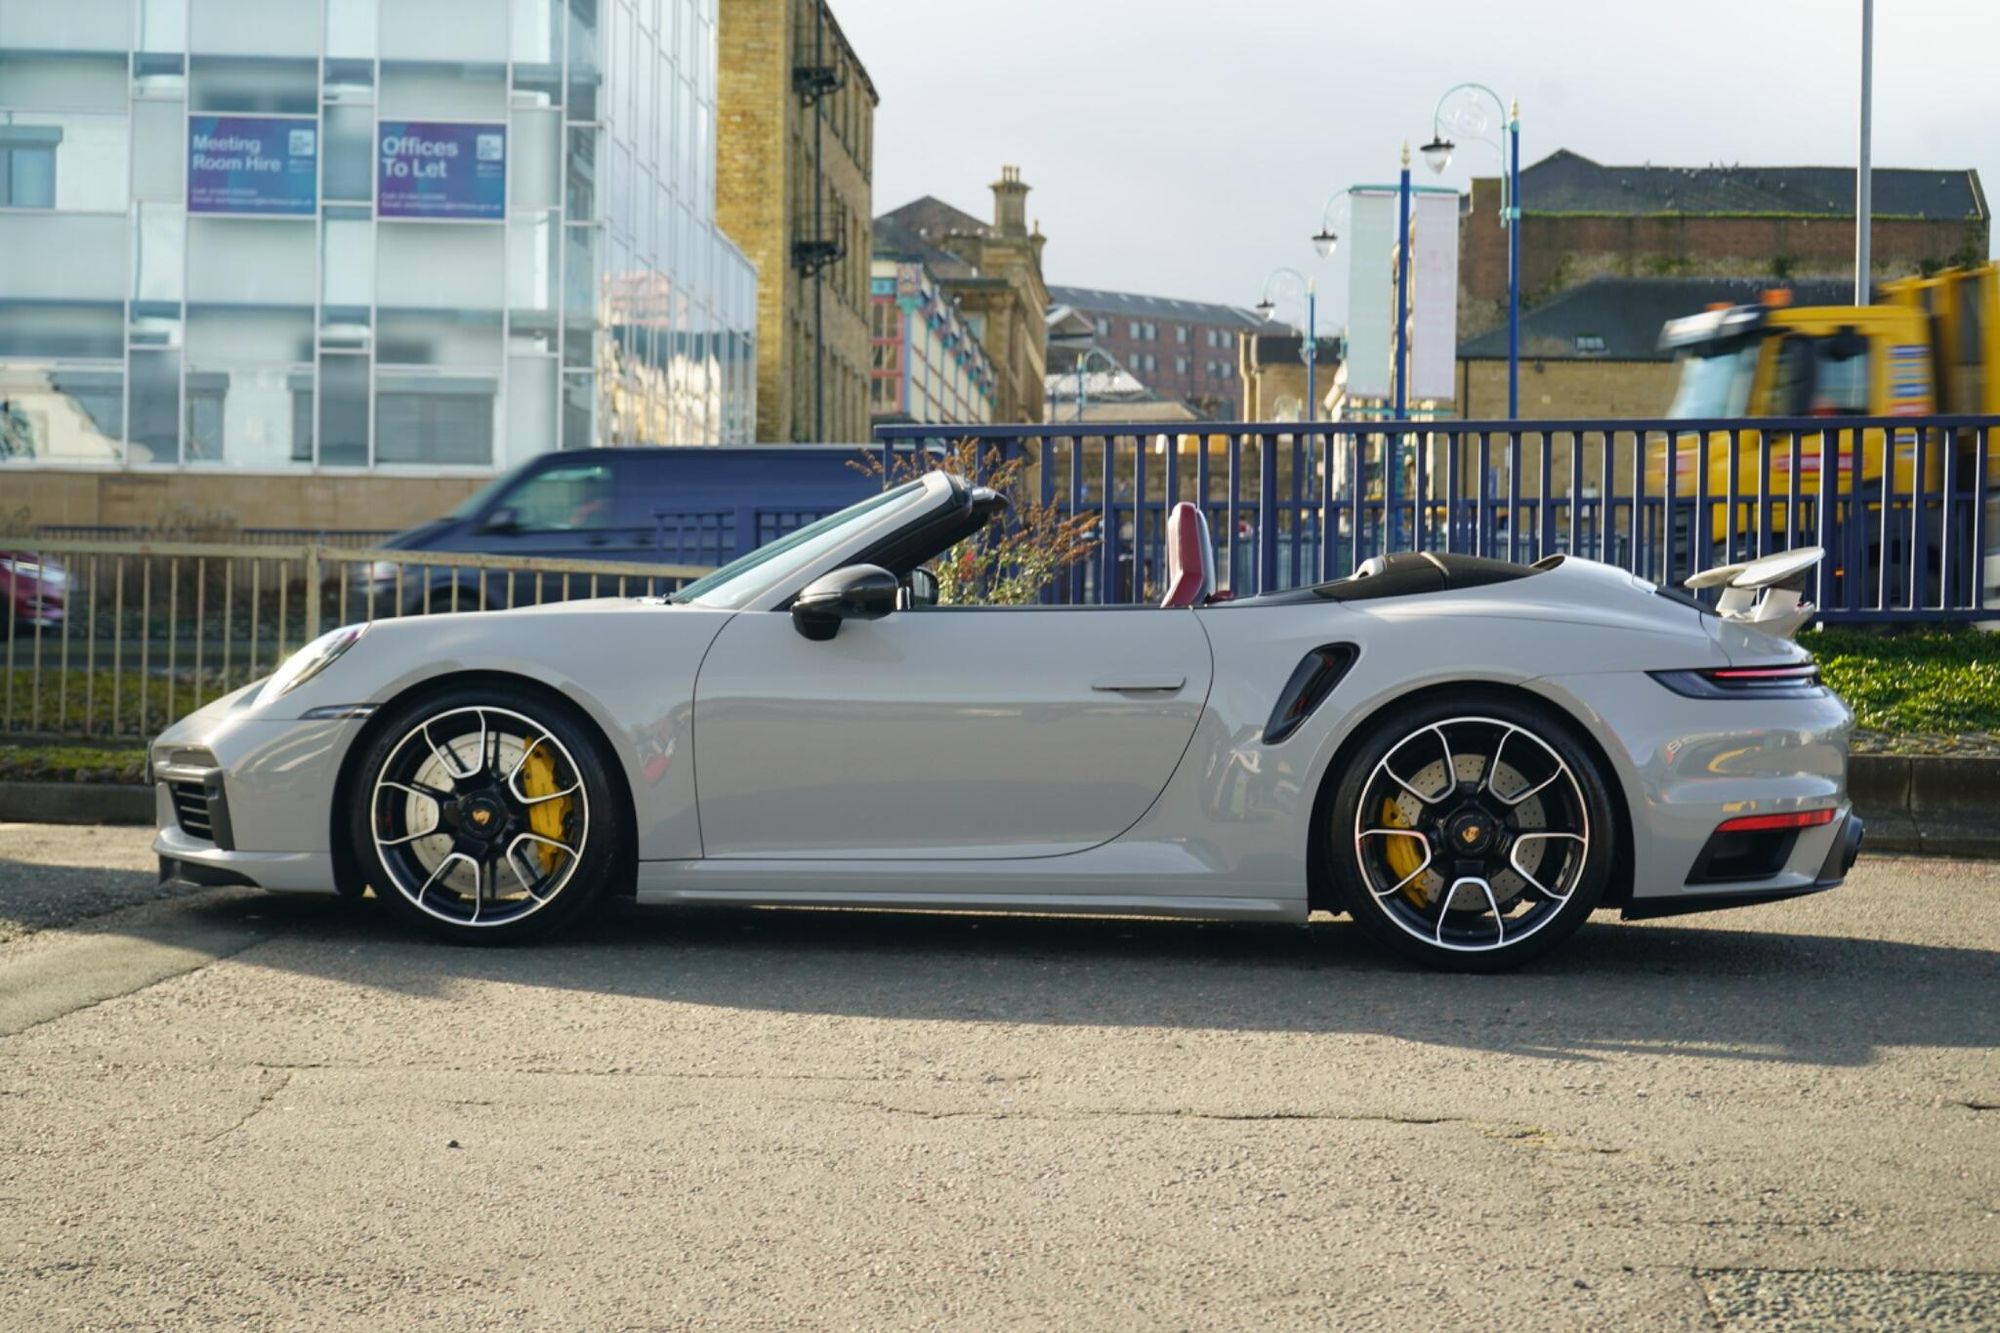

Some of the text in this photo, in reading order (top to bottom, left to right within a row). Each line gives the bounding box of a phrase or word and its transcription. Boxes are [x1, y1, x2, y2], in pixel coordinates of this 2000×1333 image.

[193, 134, 261, 155] Meeting
[382, 136, 458, 157] Offices
[193, 154, 241, 170] Room
[246, 156, 281, 172] Hire
[382, 157, 447, 178] To Let
